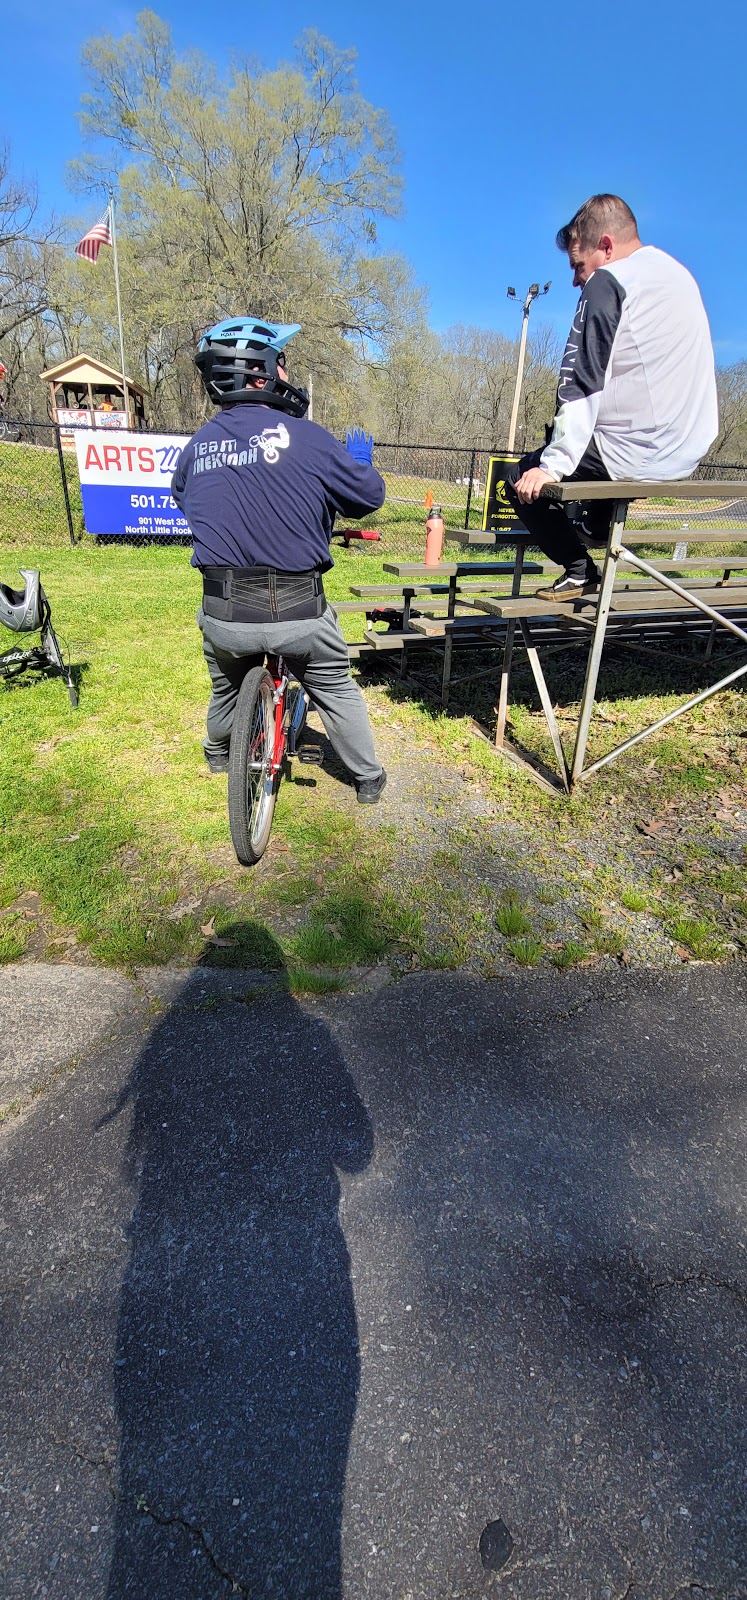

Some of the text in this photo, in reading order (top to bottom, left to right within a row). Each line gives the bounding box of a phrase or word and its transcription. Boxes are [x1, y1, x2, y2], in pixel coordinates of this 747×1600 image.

[85, 444, 154, 472] ARTS
[138, 517, 152, 525] 901
[154, 517, 174, 525] West
